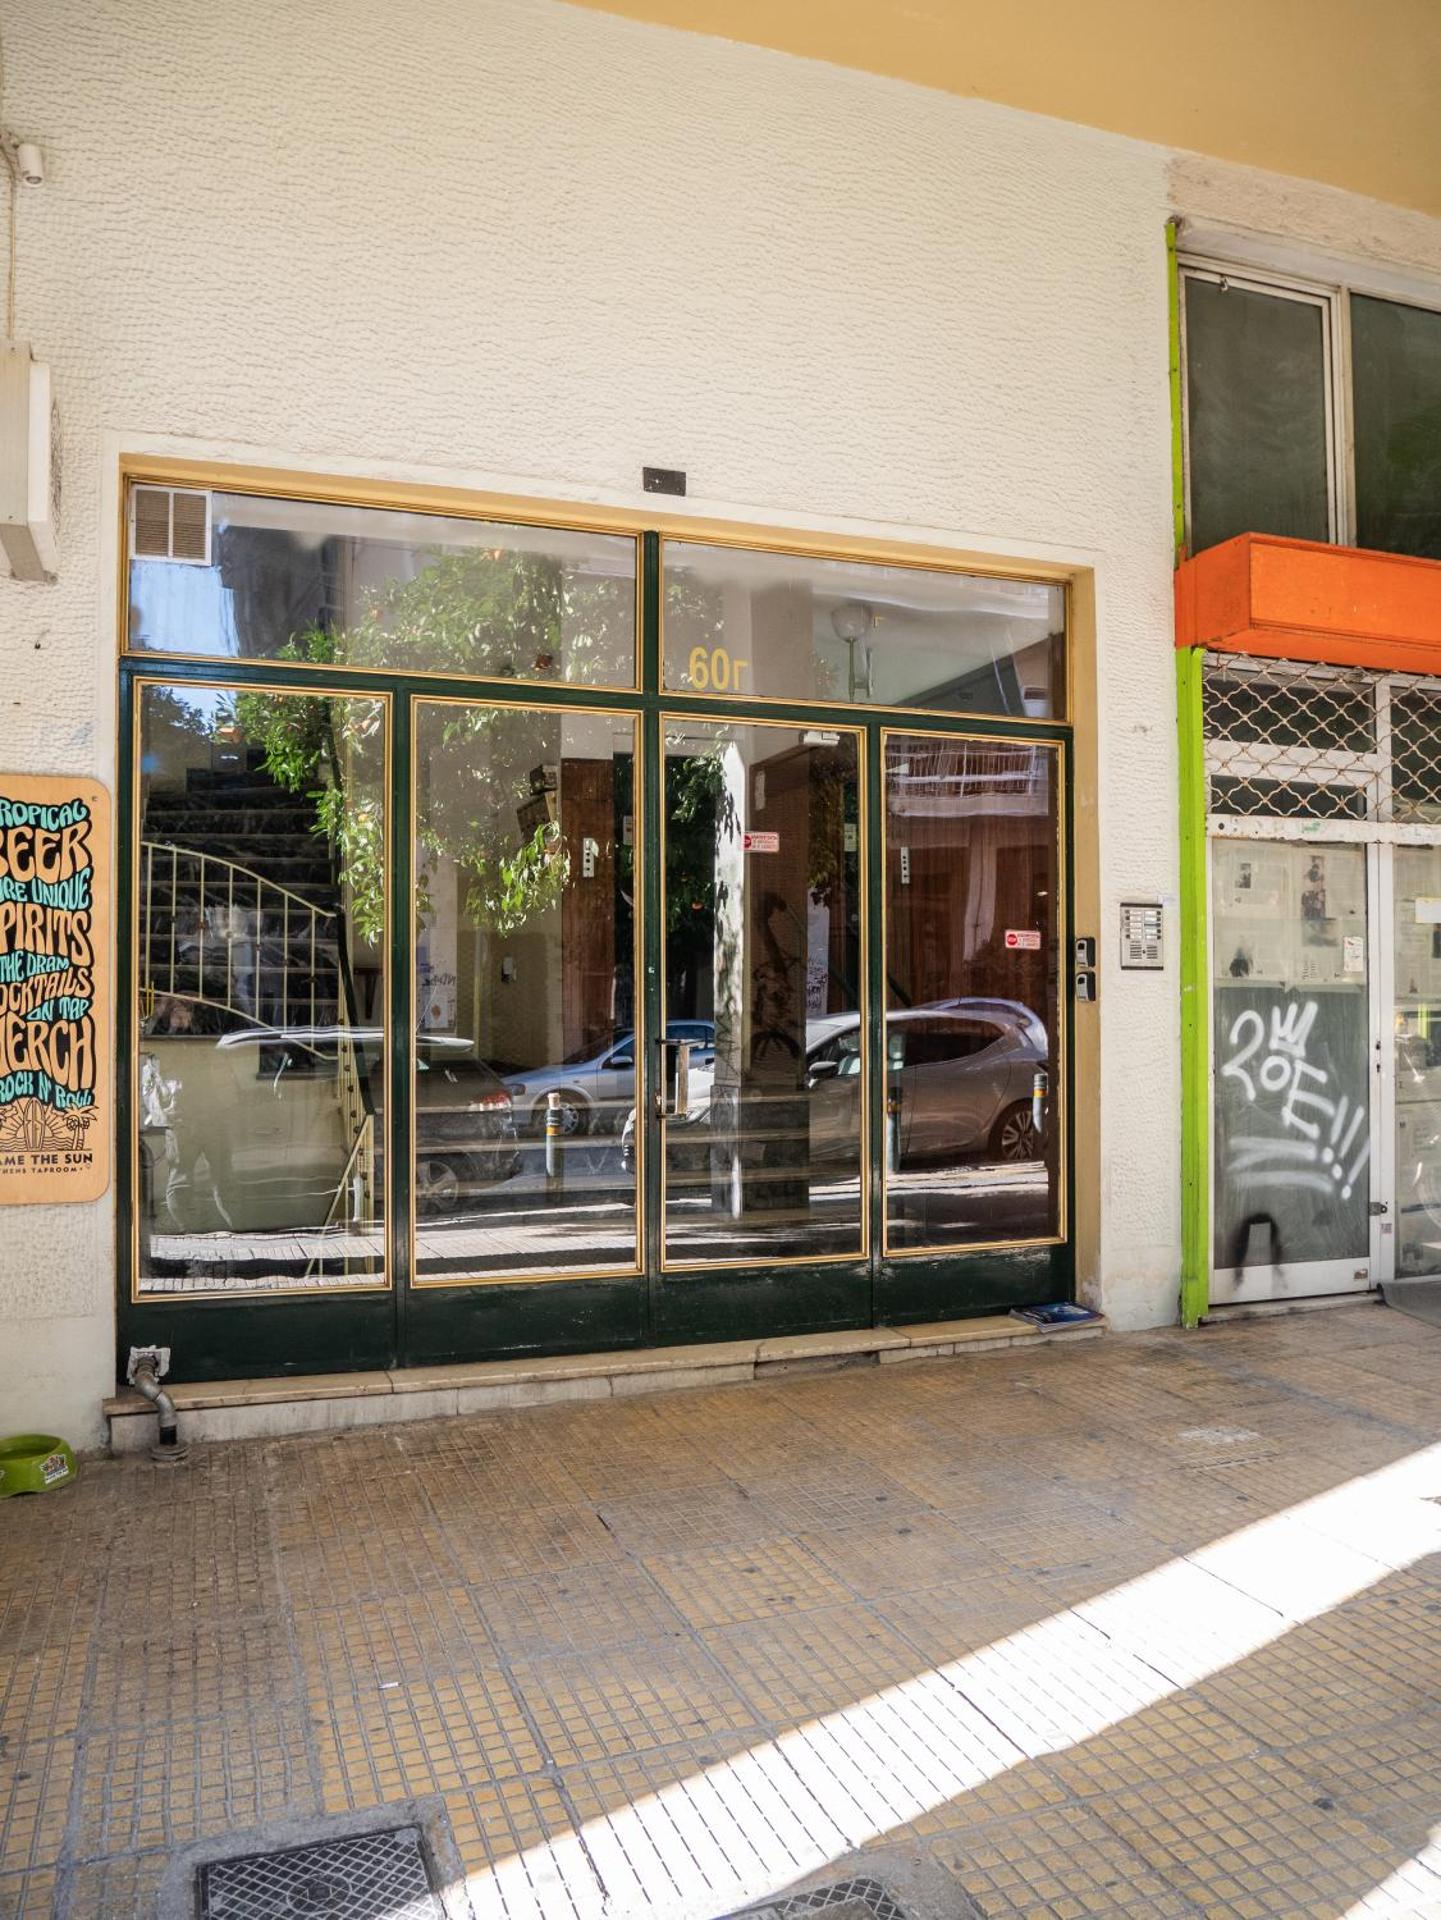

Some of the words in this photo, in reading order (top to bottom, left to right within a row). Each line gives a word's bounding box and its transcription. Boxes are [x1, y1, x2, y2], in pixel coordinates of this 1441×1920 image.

[0, 876, 28, 902] RE
[31, 867, 90, 911] UNIQUE
[26, 954, 70, 977] DRAM
[26, 999, 54, 1021] ON
[59, 996, 89, 1020] TAP
[0, 1011, 93, 1092] ERCH
[55, 1084, 92, 1109] ROLL
[0, 1155, 25, 1166] ME
[31, 1153, 58, 1165] THE
[65, 1152, 93, 1164] SUN
[32, 1164, 77, 1174] TAPROOM
